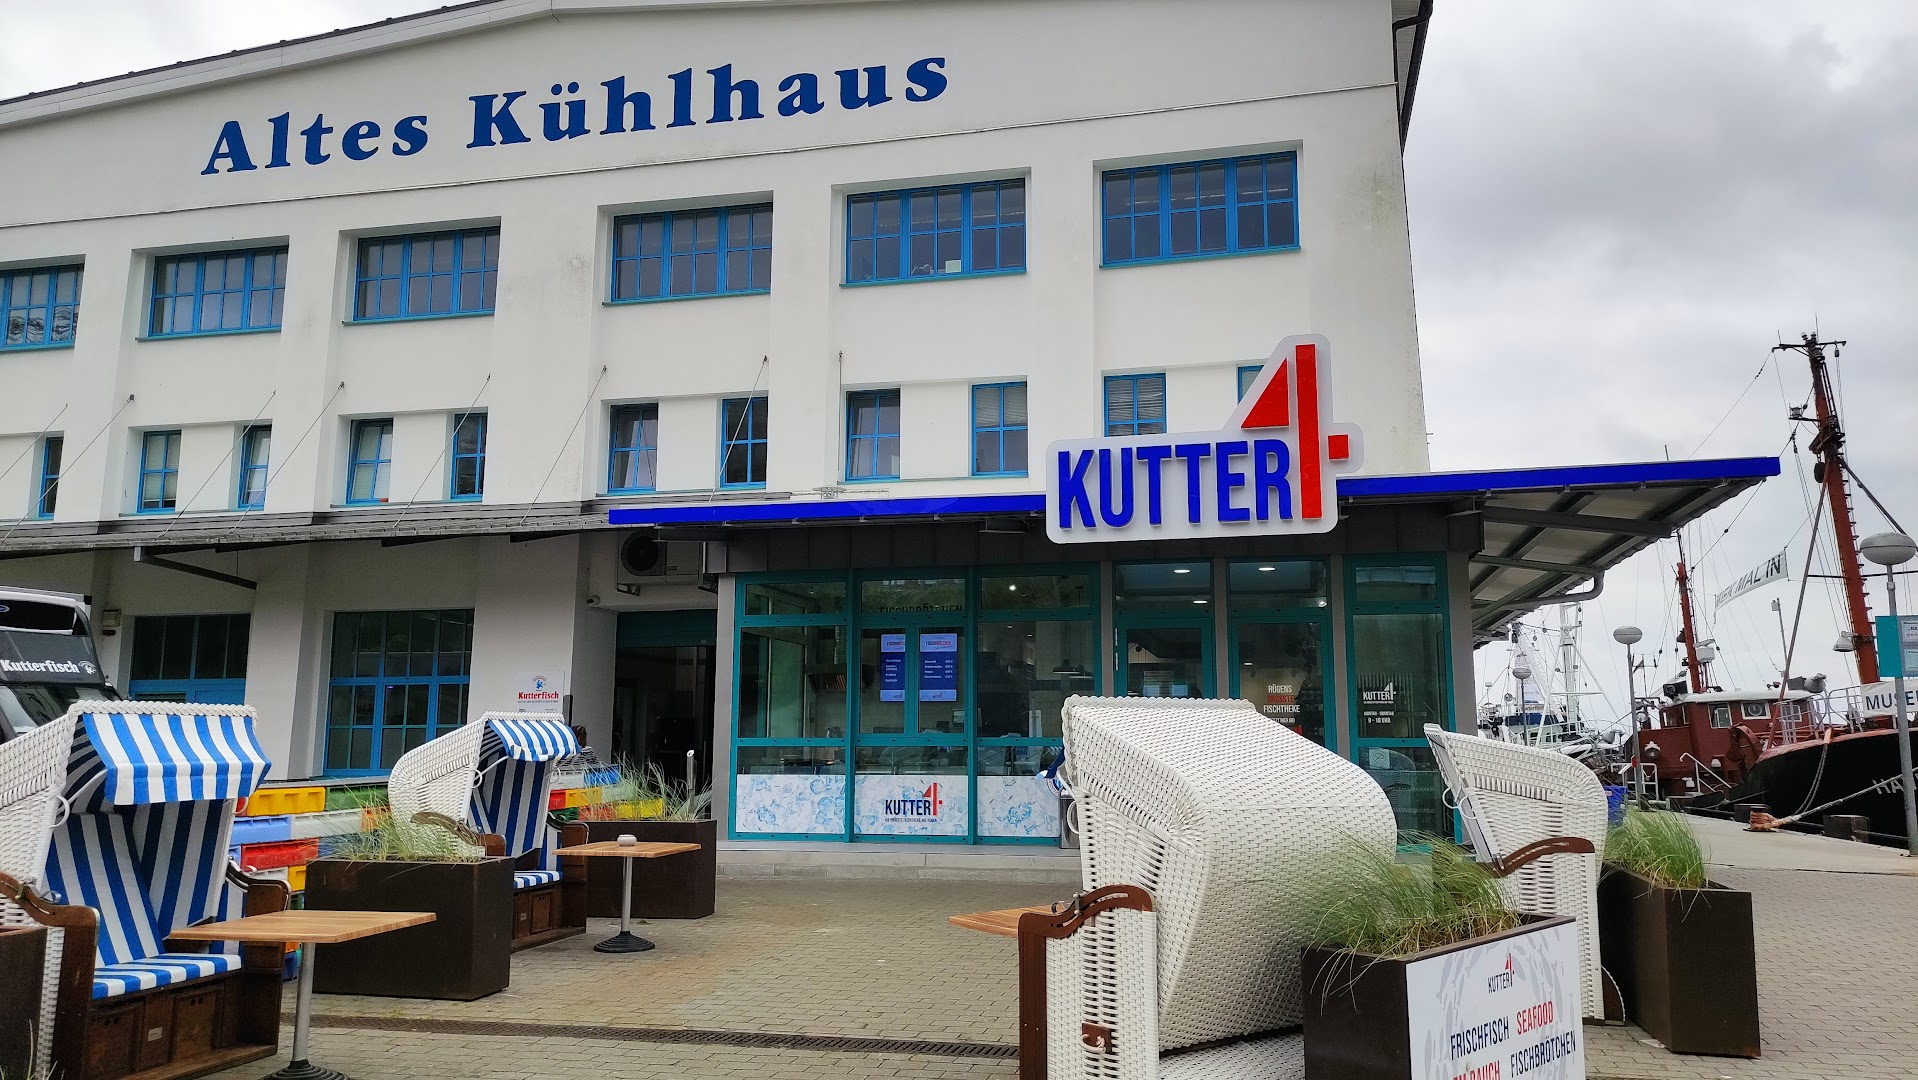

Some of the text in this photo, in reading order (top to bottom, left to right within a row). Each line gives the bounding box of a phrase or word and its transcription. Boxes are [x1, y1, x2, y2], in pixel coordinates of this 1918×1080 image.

[201, 57, 948, 175] Altes Kühlhaus
[1766, 554, 1781, 578] IN
[0, 660, 80, 673] Kutterfisch
[517, 690, 559, 700] Kutterfisch
[1268, 684, 1293, 693] RÜGENS
[1263, 704, 1301, 713] FISCHTHEKE
[1865, 690, 1918, 711] MUE
[1450, 1000, 1554, 1061] FRISCHFISCH SEAFOOD
[1510, 1029, 1577, 1078] FISCHBRÖTCHEN
